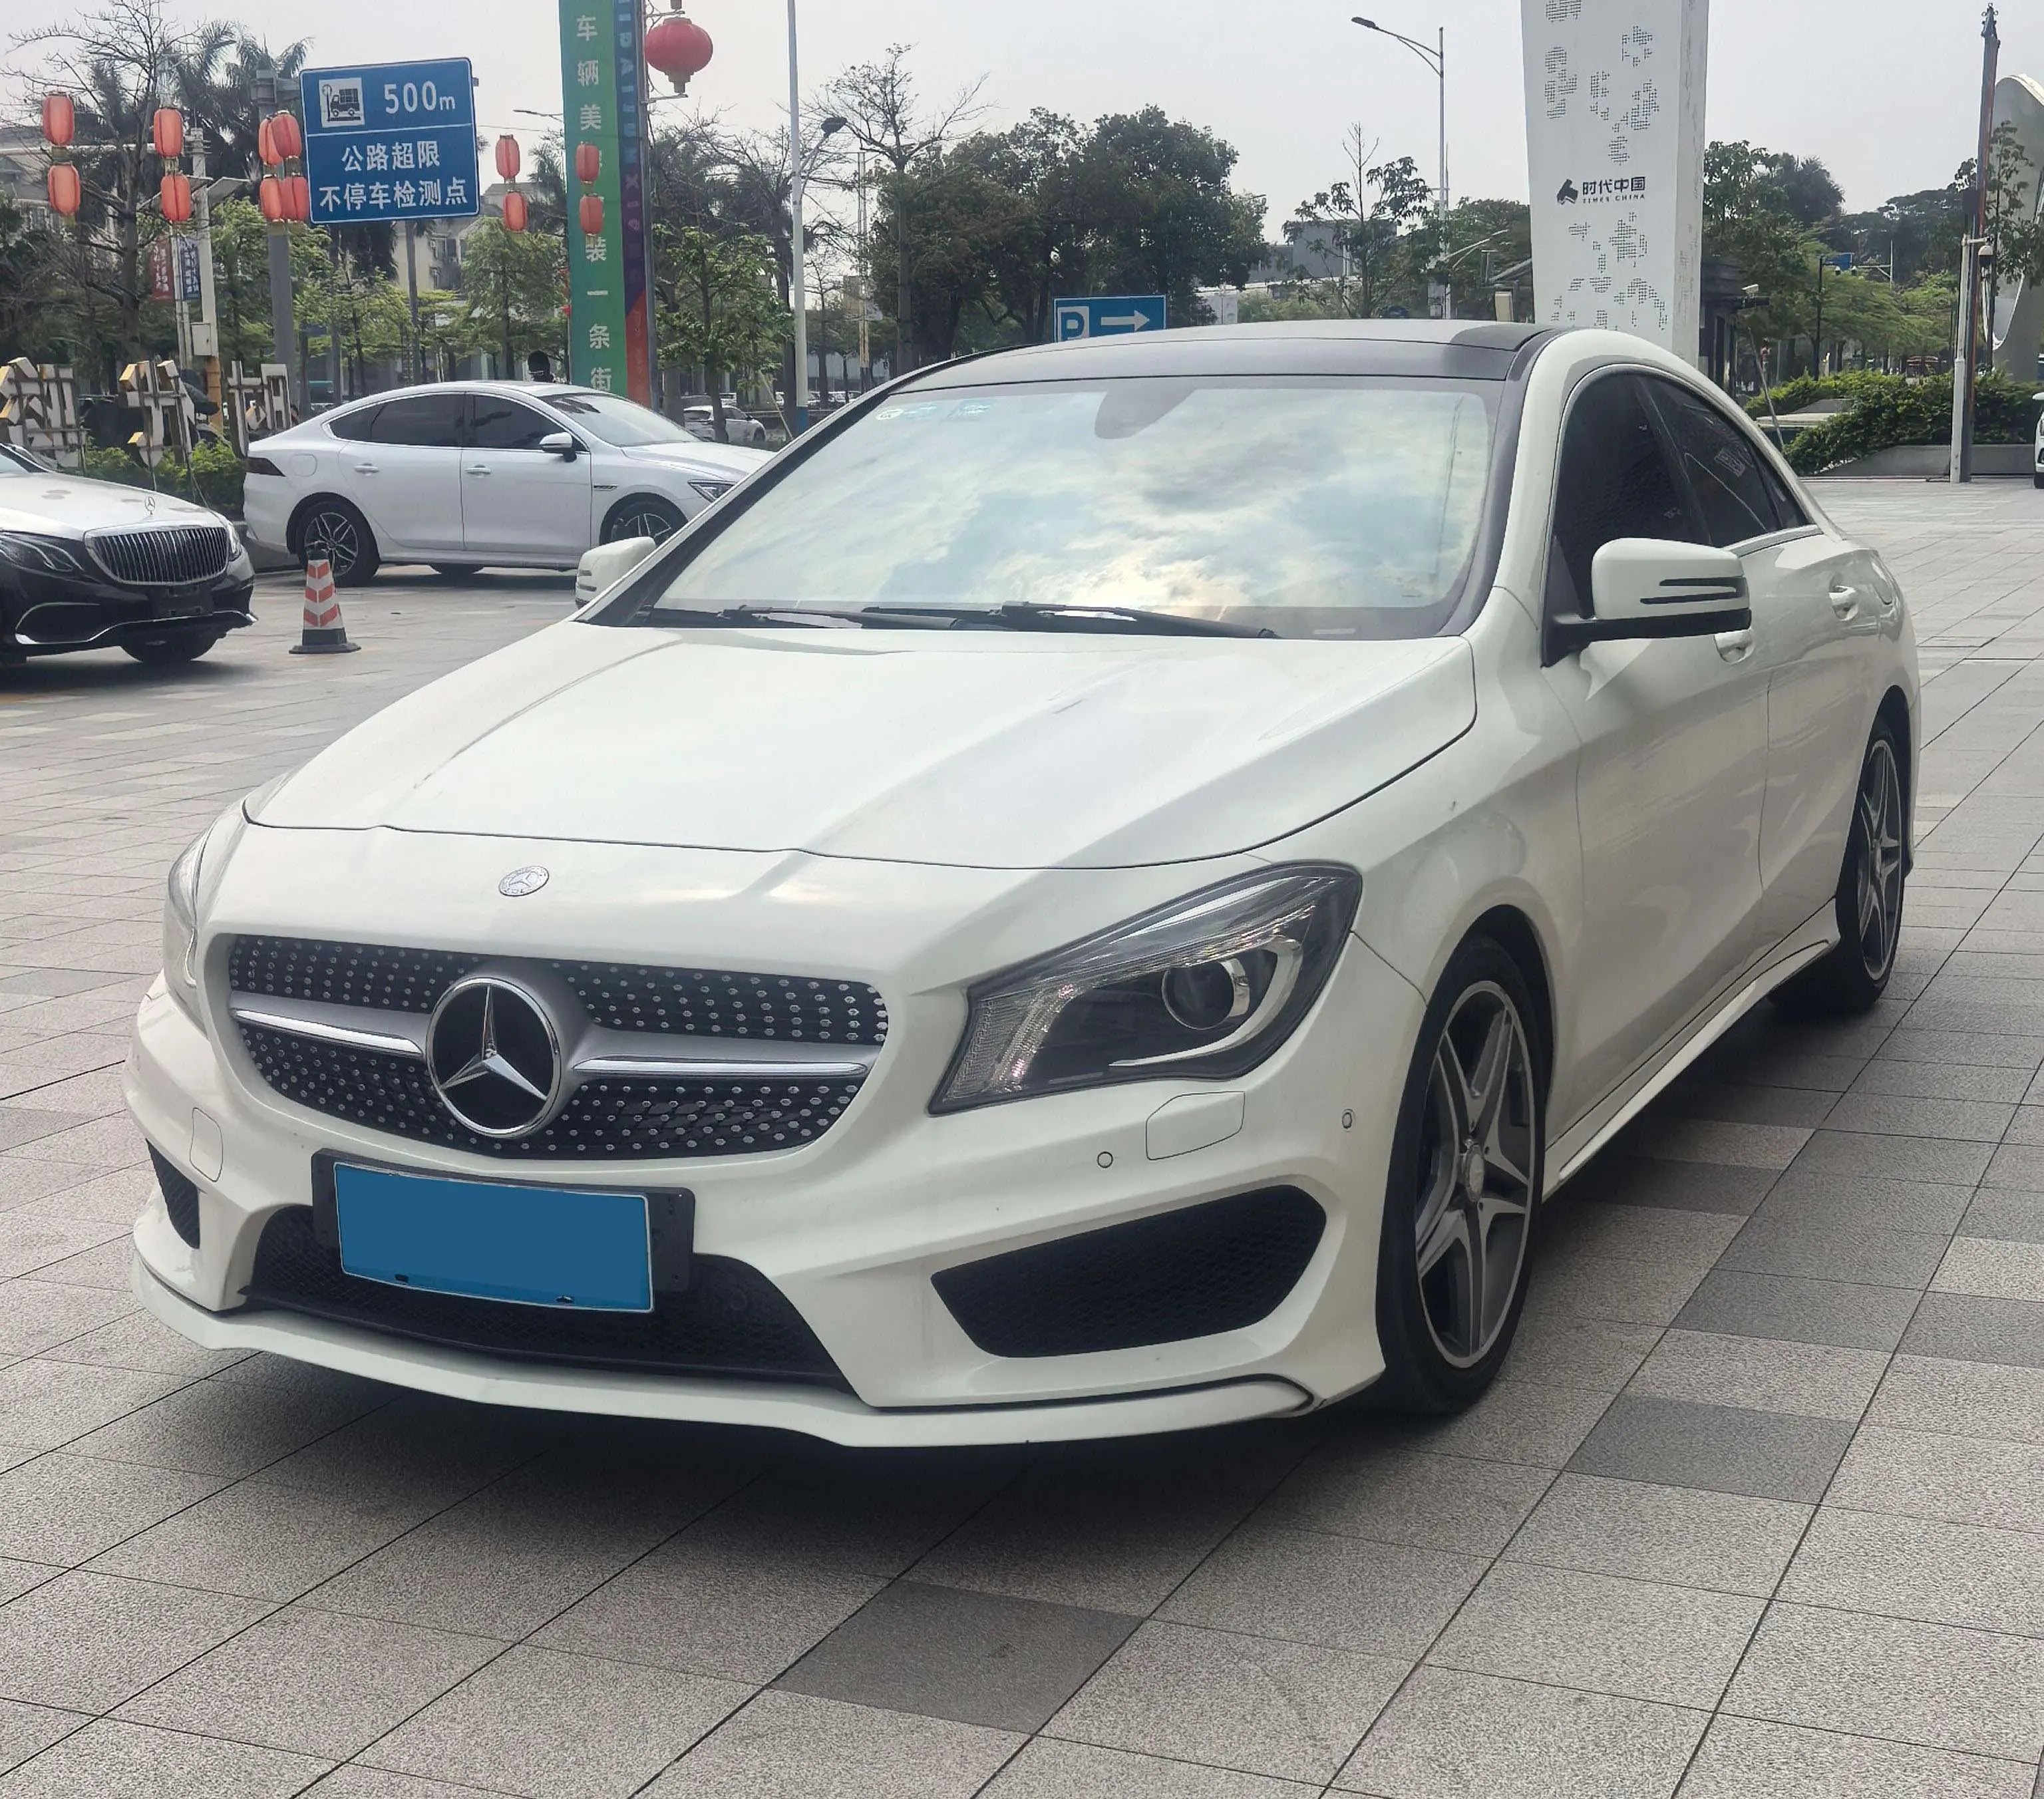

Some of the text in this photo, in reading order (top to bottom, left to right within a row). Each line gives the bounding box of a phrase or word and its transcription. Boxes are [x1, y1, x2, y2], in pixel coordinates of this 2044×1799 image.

[384, 81, 456, 114] 500m
[341, 140, 440, 172] 公路超限
[319, 176, 468, 212] 不停车检测点
[1582, 176, 1645, 195] 时代中国
[576, 15, 611, 391] 车辆美装一条街
[1061, 311, 1085, 341] P
